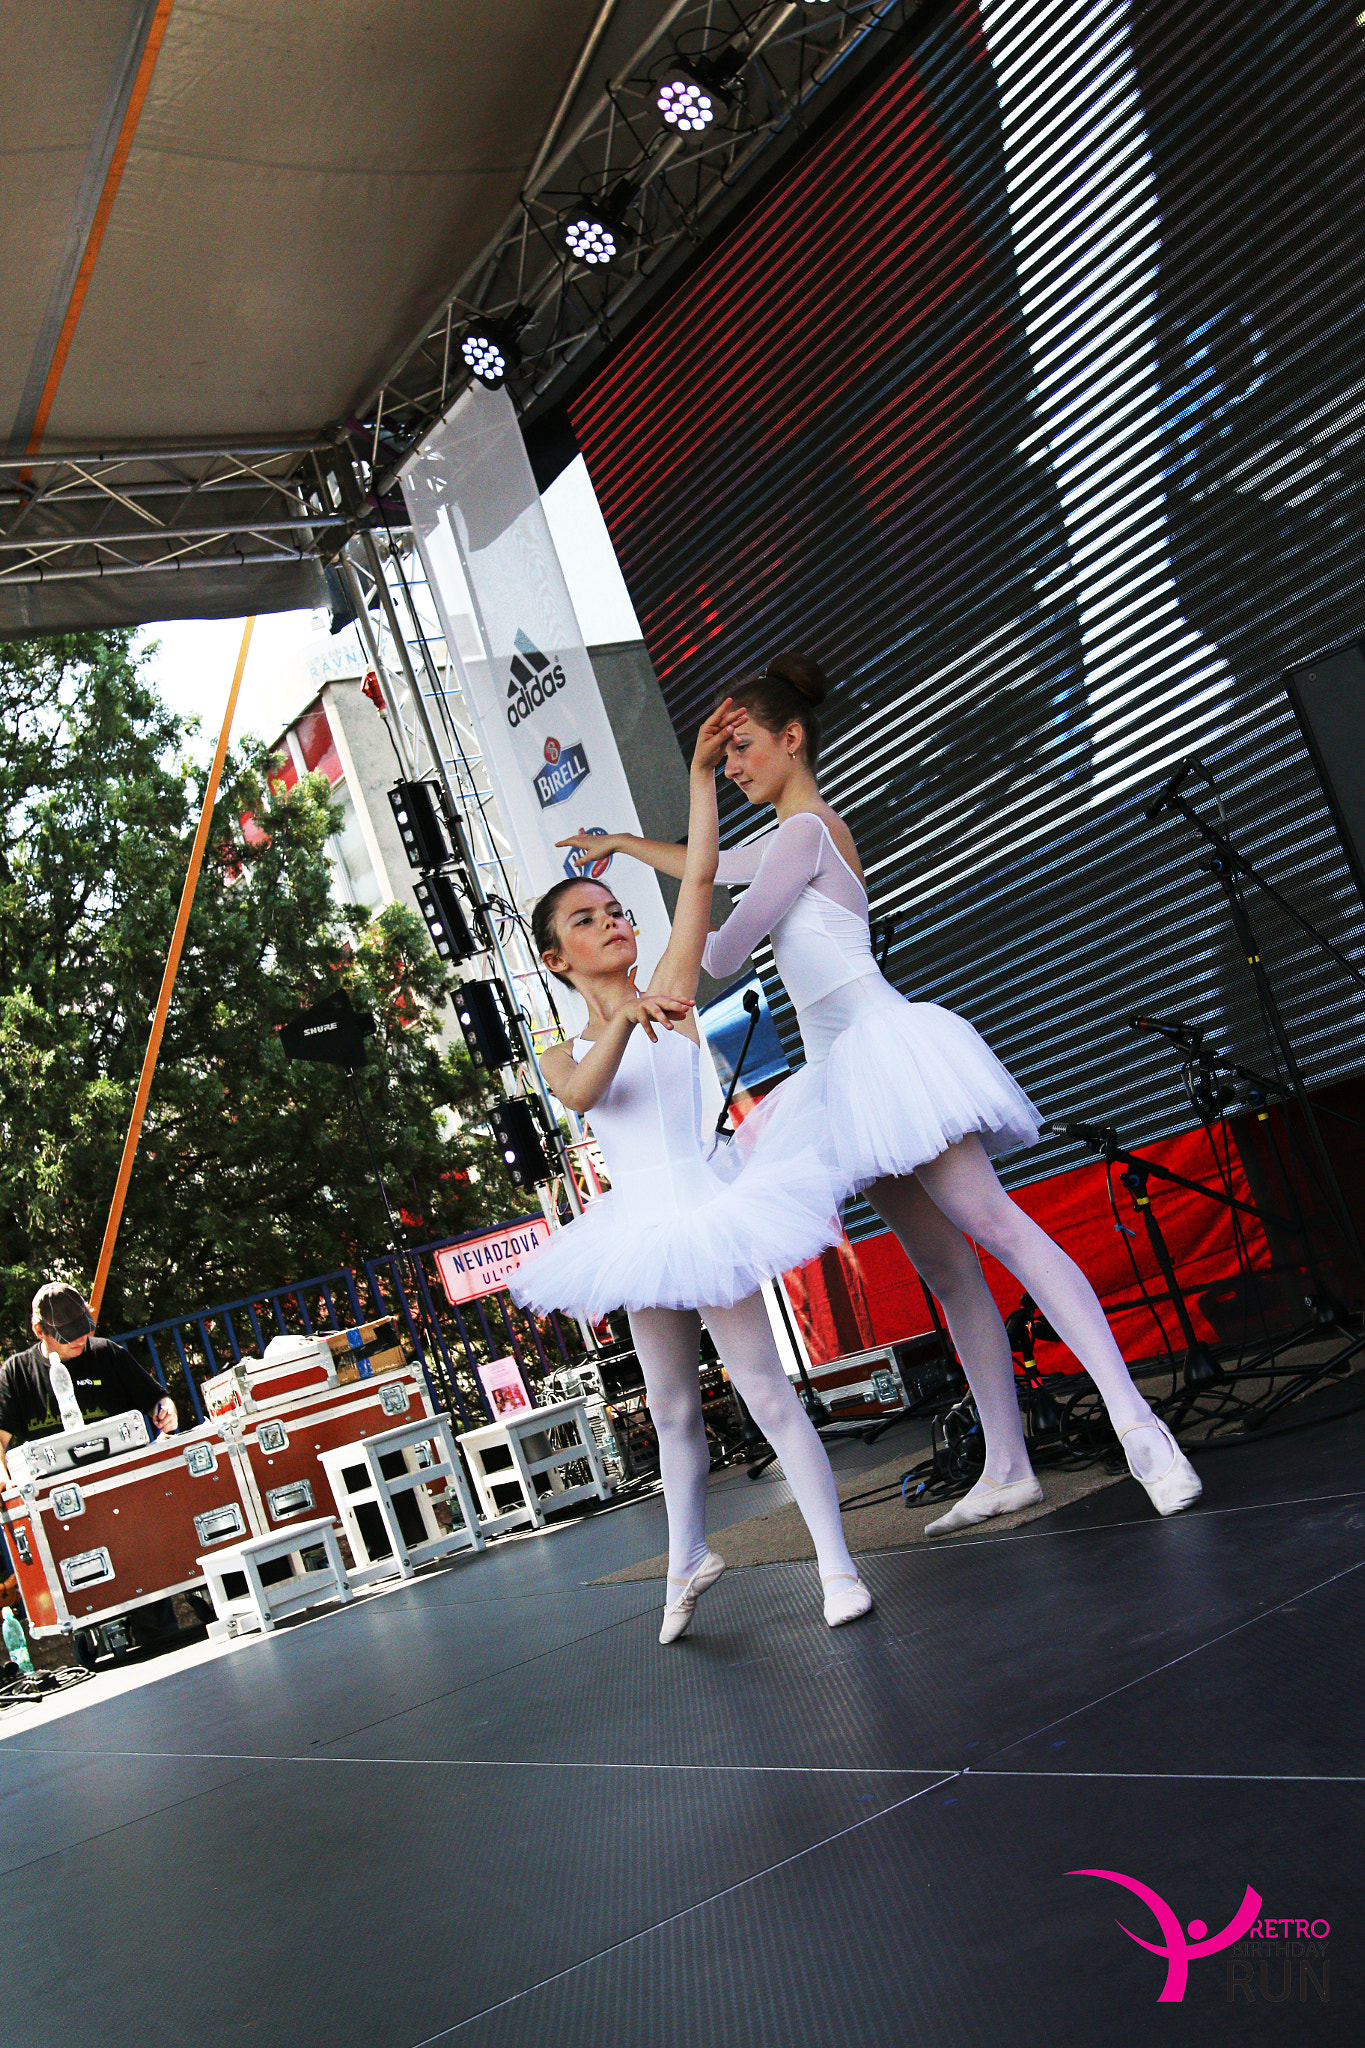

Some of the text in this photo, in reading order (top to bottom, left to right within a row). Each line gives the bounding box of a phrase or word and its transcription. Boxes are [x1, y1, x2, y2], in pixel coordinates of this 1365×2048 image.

[507, 664, 566, 728] adidas
[537, 755, 586, 802] BIRELL
[303, 1022, 338, 1036] SHURE
[482, 1262, 521, 1285] ULC
